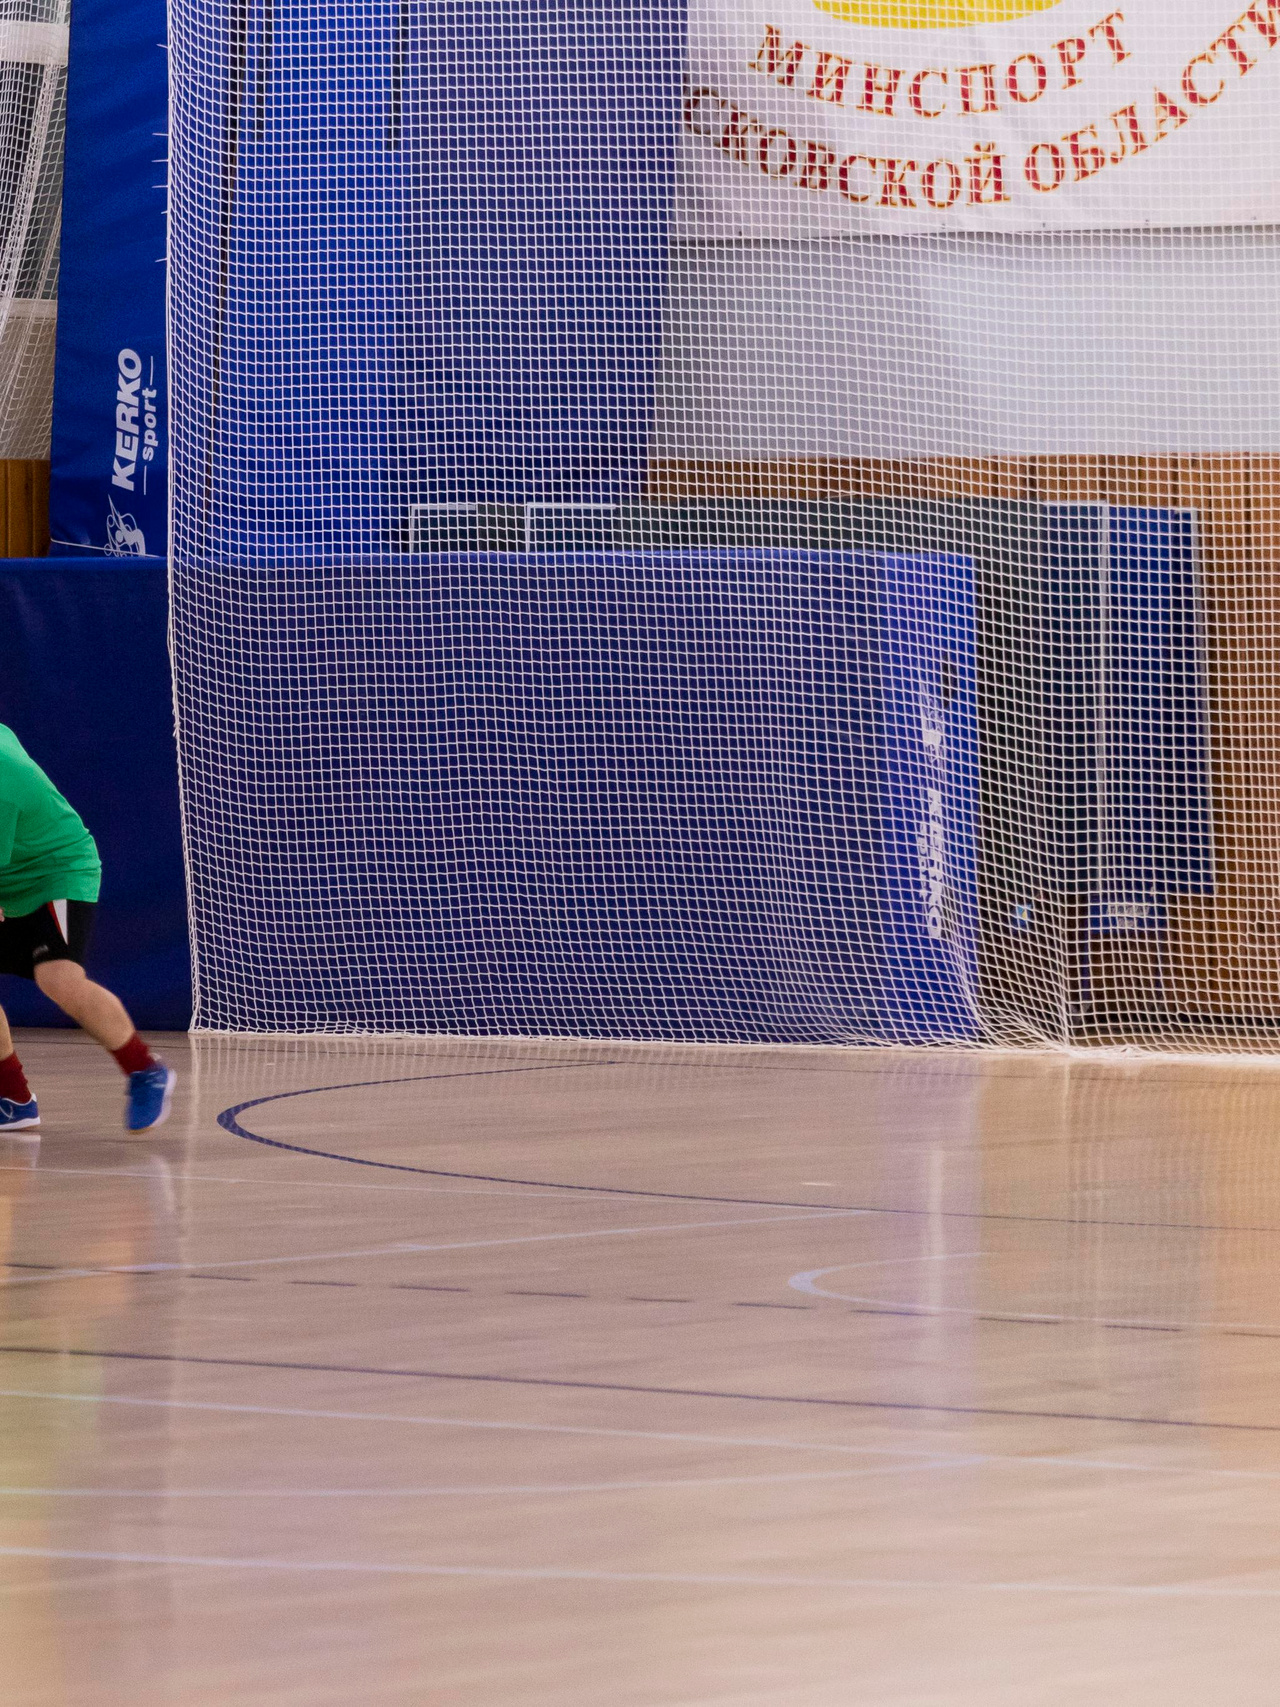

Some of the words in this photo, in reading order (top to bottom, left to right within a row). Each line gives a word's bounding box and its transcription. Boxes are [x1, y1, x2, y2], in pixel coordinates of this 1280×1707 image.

[748, 9, 1133, 118] МИНСПОРТ
[684, 73, 1013, 208] СКОВСКОЙ
[112, 348, 142, 491] KERKO
[142, 387, 158, 461] sport
